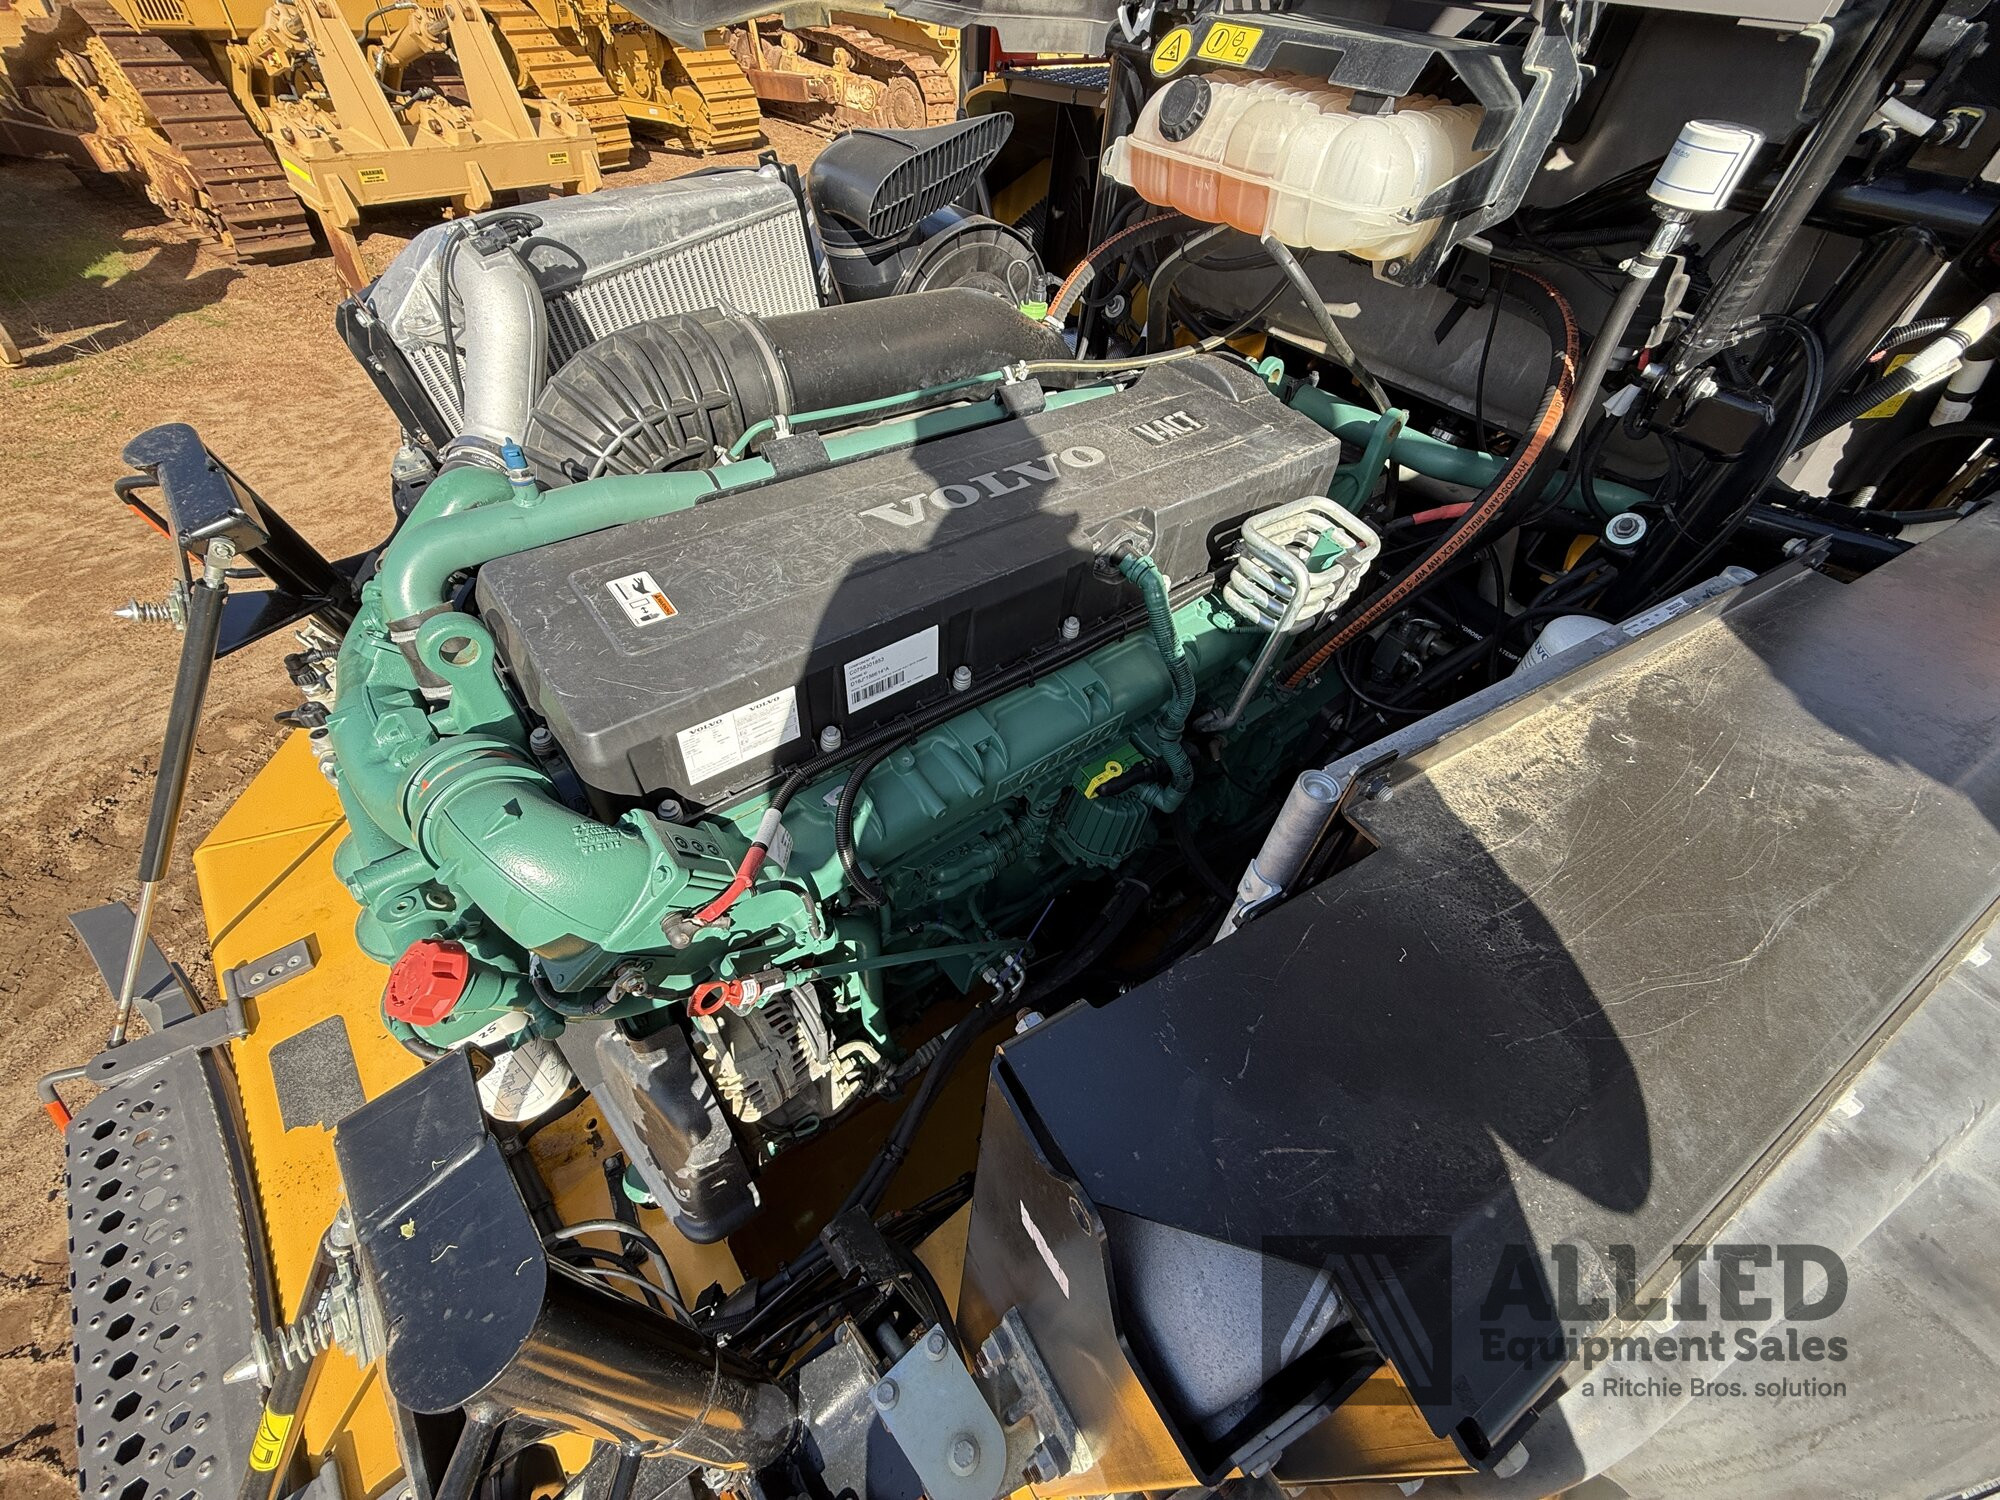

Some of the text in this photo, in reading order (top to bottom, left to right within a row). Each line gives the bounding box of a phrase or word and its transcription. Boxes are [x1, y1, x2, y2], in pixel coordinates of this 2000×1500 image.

[858, 446, 1106, 526] VOLVO
[1486, 460, 1528, 514] HYDROSCAND
[1442, 515, 1486, 556] MULTIFLEX
[1425, 554, 1442, 571] HW
[1412, 568, 1427, 582] WP
[1390, 586, 1406, 600] Bar
[1457, 624, 1484, 640] YDROSC
[1535, 641, 1551, 661] LVO
[749, 696, 780, 712] VOLVO
[689, 719, 723, 735] VOLVO
